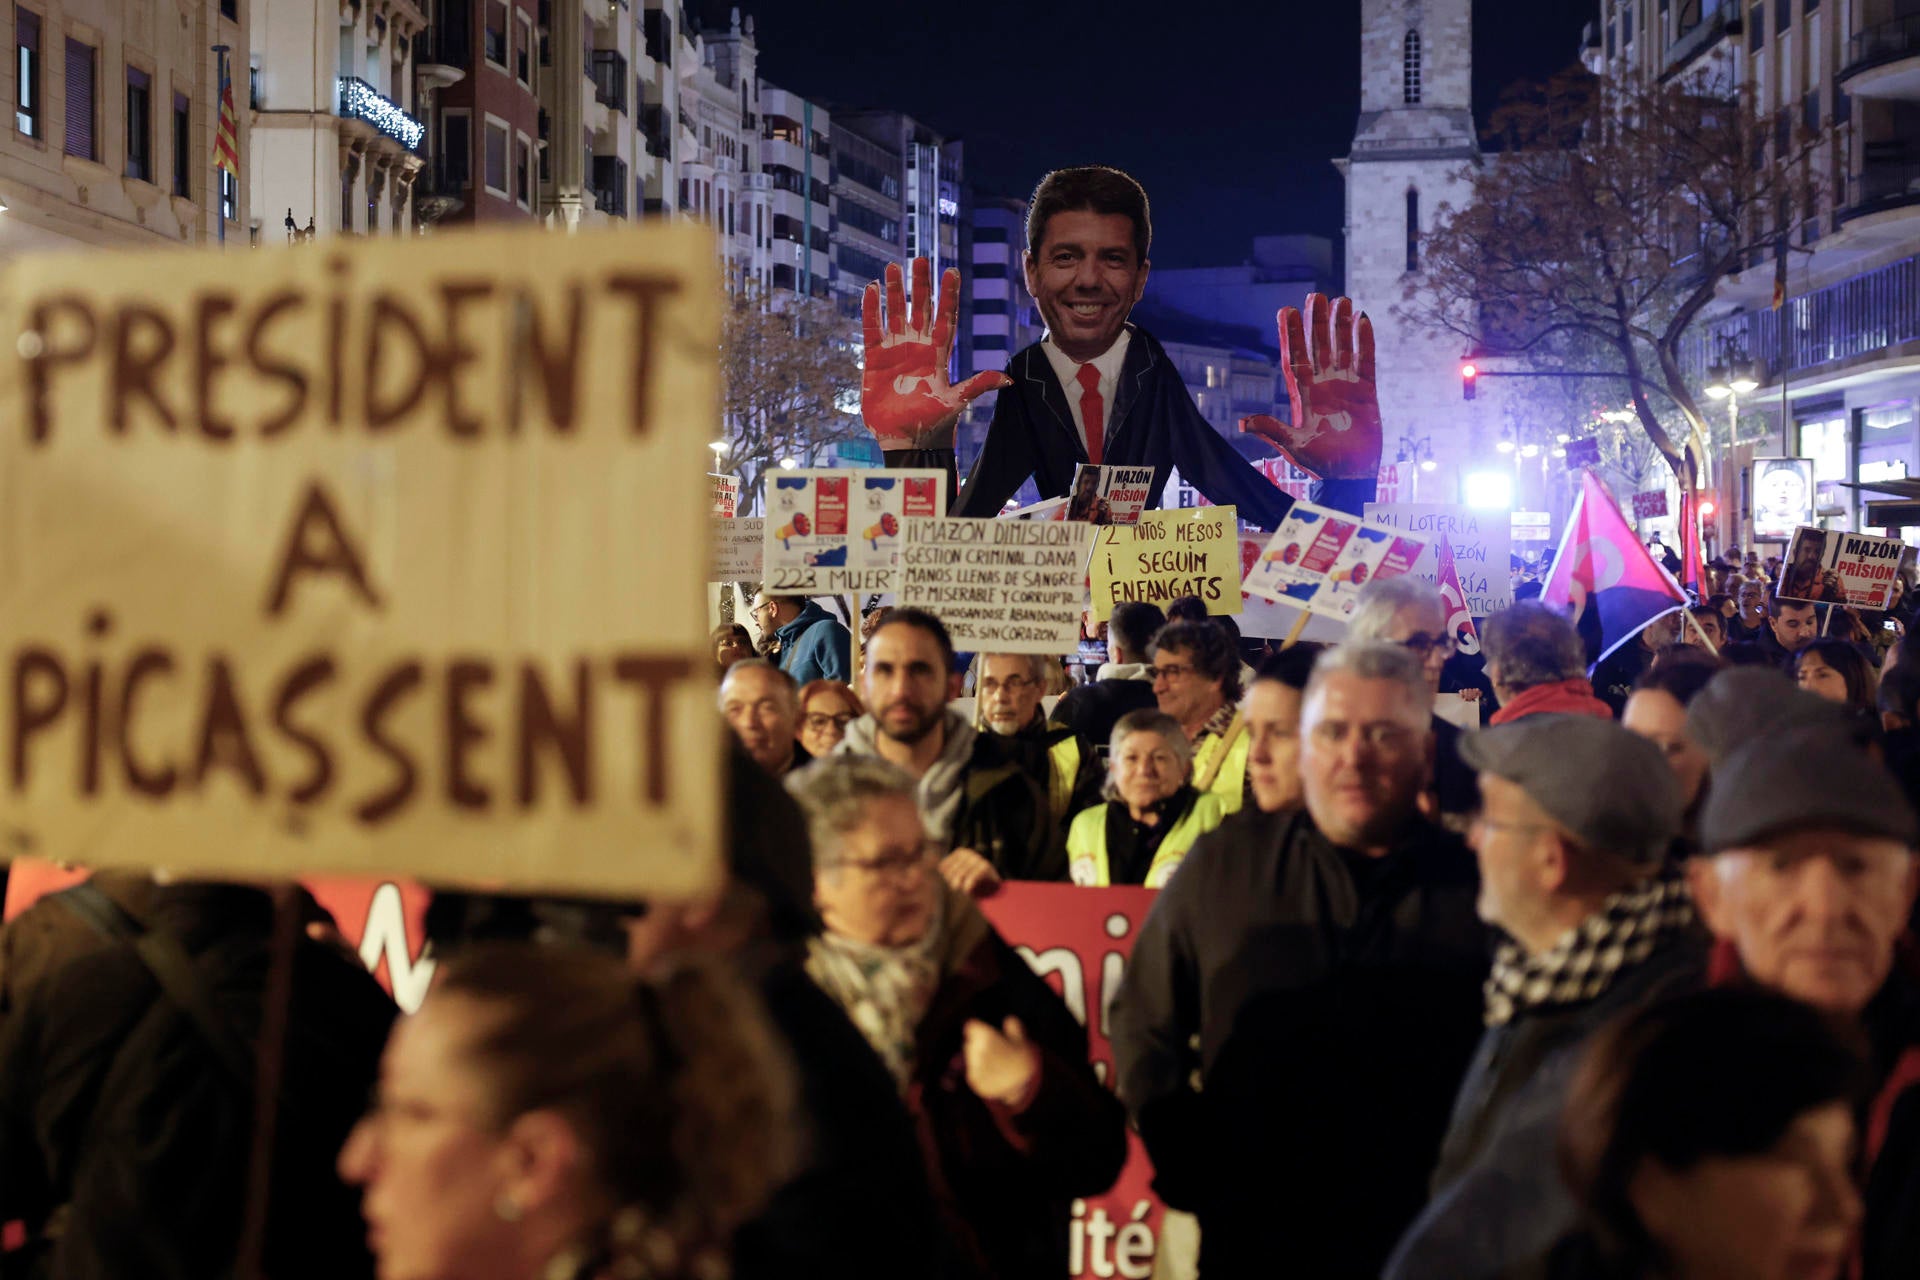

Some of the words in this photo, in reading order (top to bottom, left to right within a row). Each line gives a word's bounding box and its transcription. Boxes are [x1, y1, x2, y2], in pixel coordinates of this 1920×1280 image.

[1114, 468, 1152, 484] MAZÓN
[1109, 488, 1148, 502] PRISIÓN
[743, 520, 763, 530] SUD
[1103, 525, 1120, 545] 2
[1176, 521, 1223, 543] MESOS
[1376, 513, 1398, 528] MI
[1409, 513, 1480, 535] LOTERÍA
[264, 474, 386, 622] A
[1034, 549, 1077, 567] DANA
[1845, 538, 1900, 560] MAZÓN
[771, 567, 817, 590] 223
[829, 567, 897, 591] MUER
[904, 566, 952, 584] MANOS
[956, 568, 1000, 585] LLENAS
[1004, 570, 1018, 586] DE
[1837, 560, 1896, 581] PRISIÓN
[904, 584, 926, 602] PP
[926, 586, 998, 603] MISERABLE
[1001, 588, 1010, 603] Y
[1110, 576, 1223, 605] ENFANGATS
